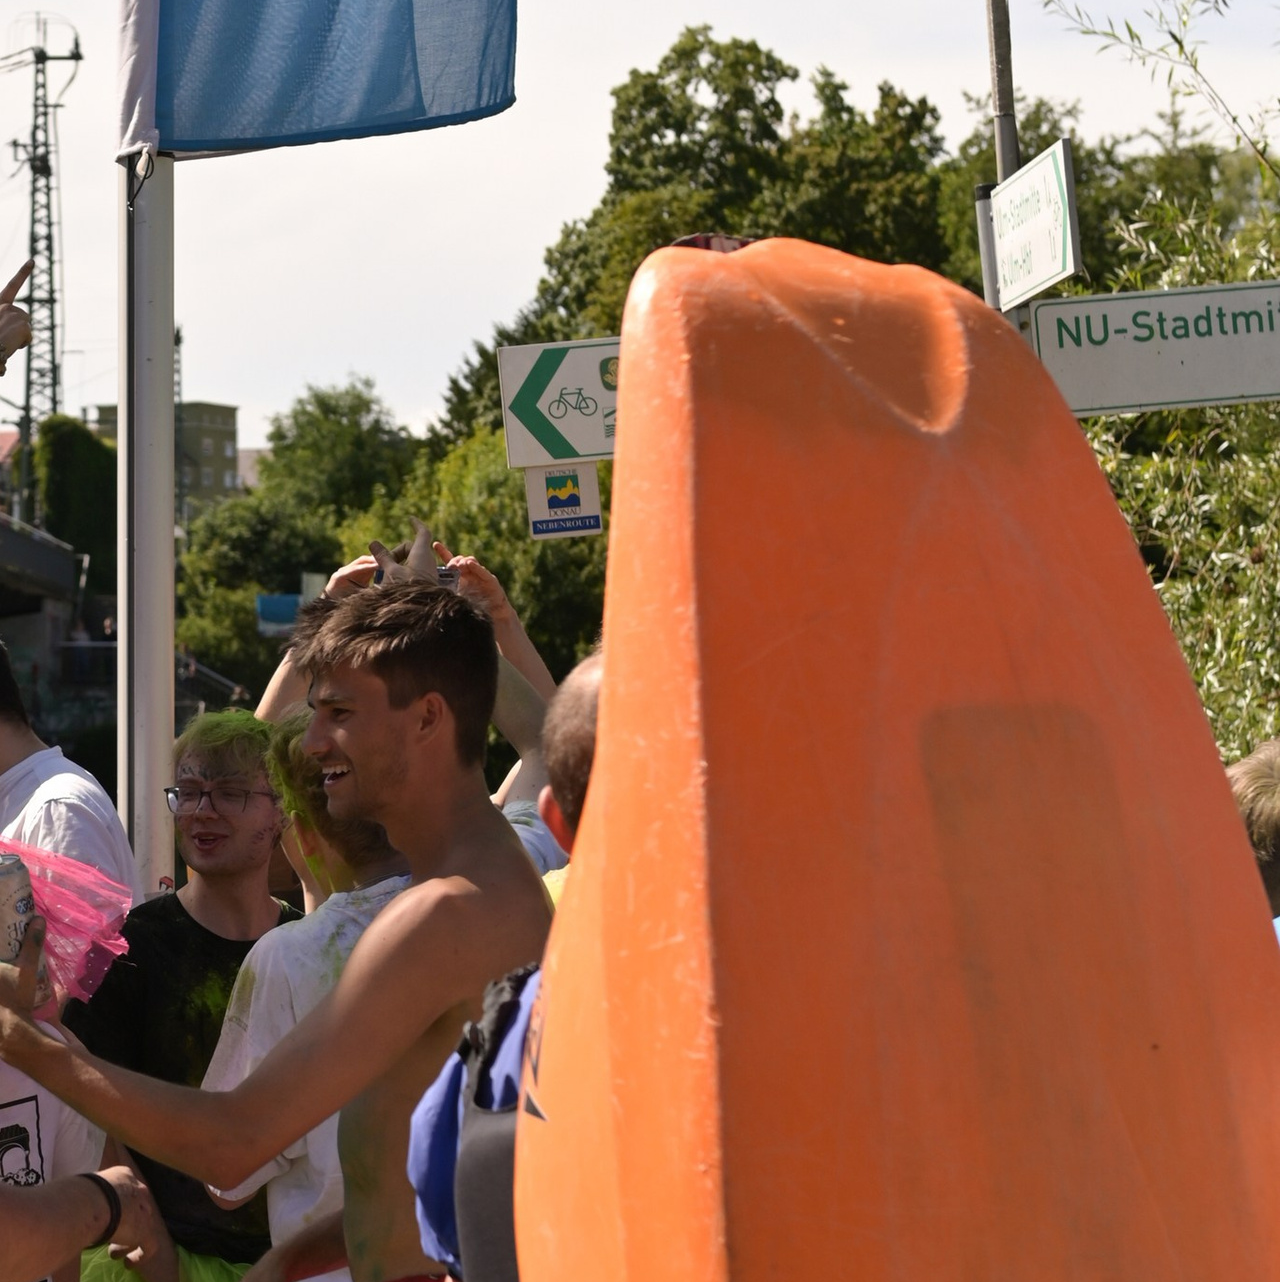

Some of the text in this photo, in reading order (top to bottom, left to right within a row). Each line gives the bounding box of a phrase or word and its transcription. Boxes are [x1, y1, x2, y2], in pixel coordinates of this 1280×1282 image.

[1055, 300, 1280, 349] NU-Stadtmi
[548, 506, 582, 518] DONAU
[536, 518, 597, 531] NEBENROUTE
